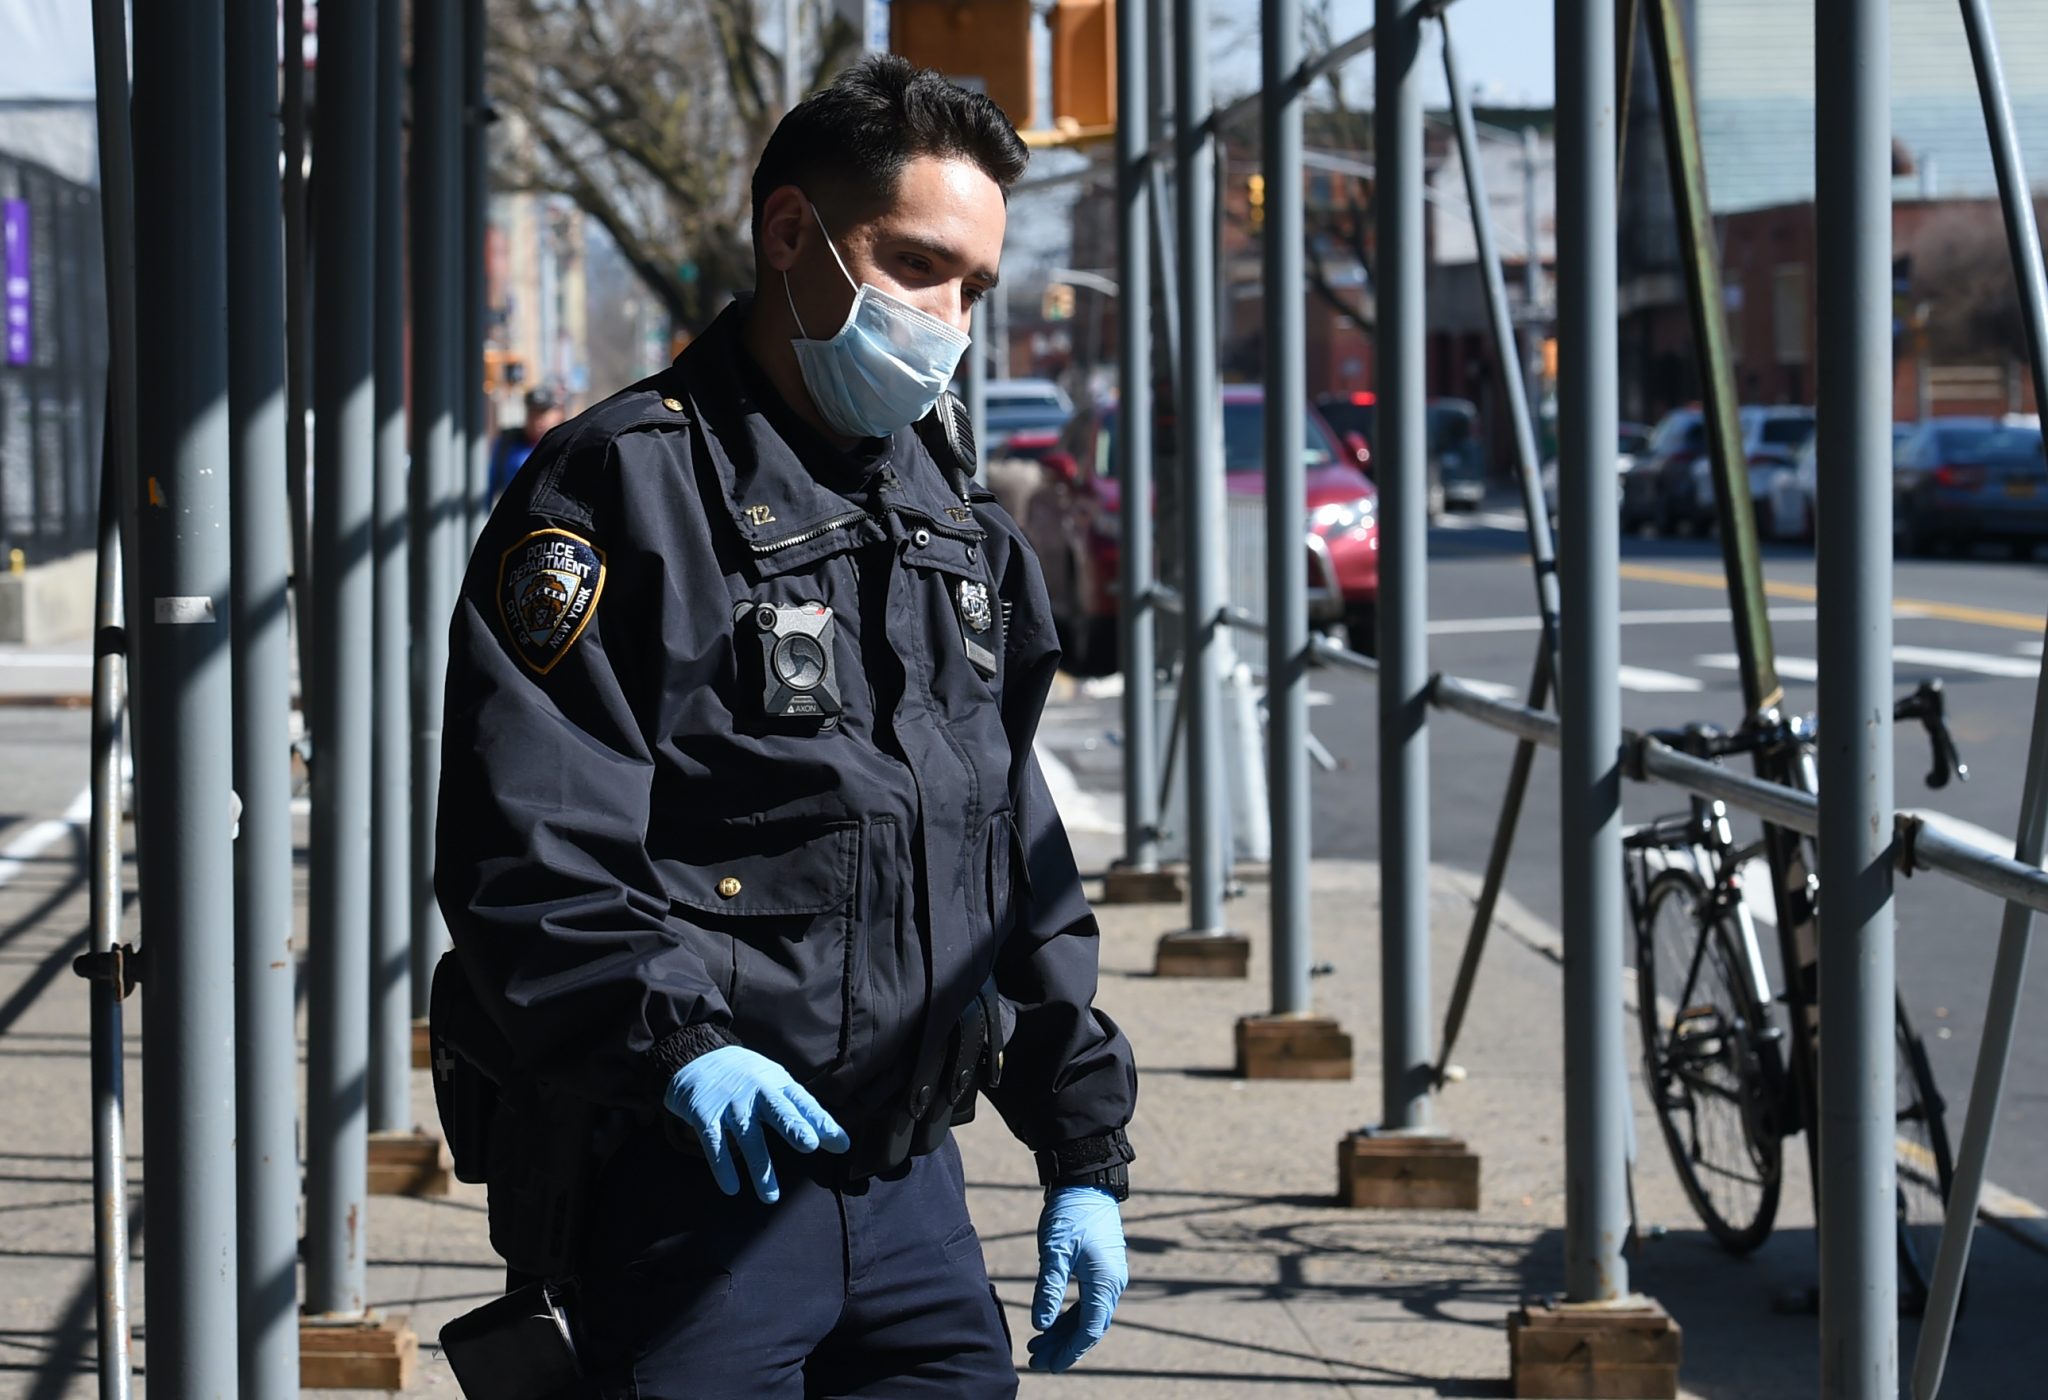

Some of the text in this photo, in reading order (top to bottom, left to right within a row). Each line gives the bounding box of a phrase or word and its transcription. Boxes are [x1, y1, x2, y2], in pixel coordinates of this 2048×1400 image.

[526, 541, 576, 560] POLICE
[508, 555, 592, 588] DEPARTMENT
[549, 586, 593, 649] NEW YORK
[795, 704, 817, 712] AXON
